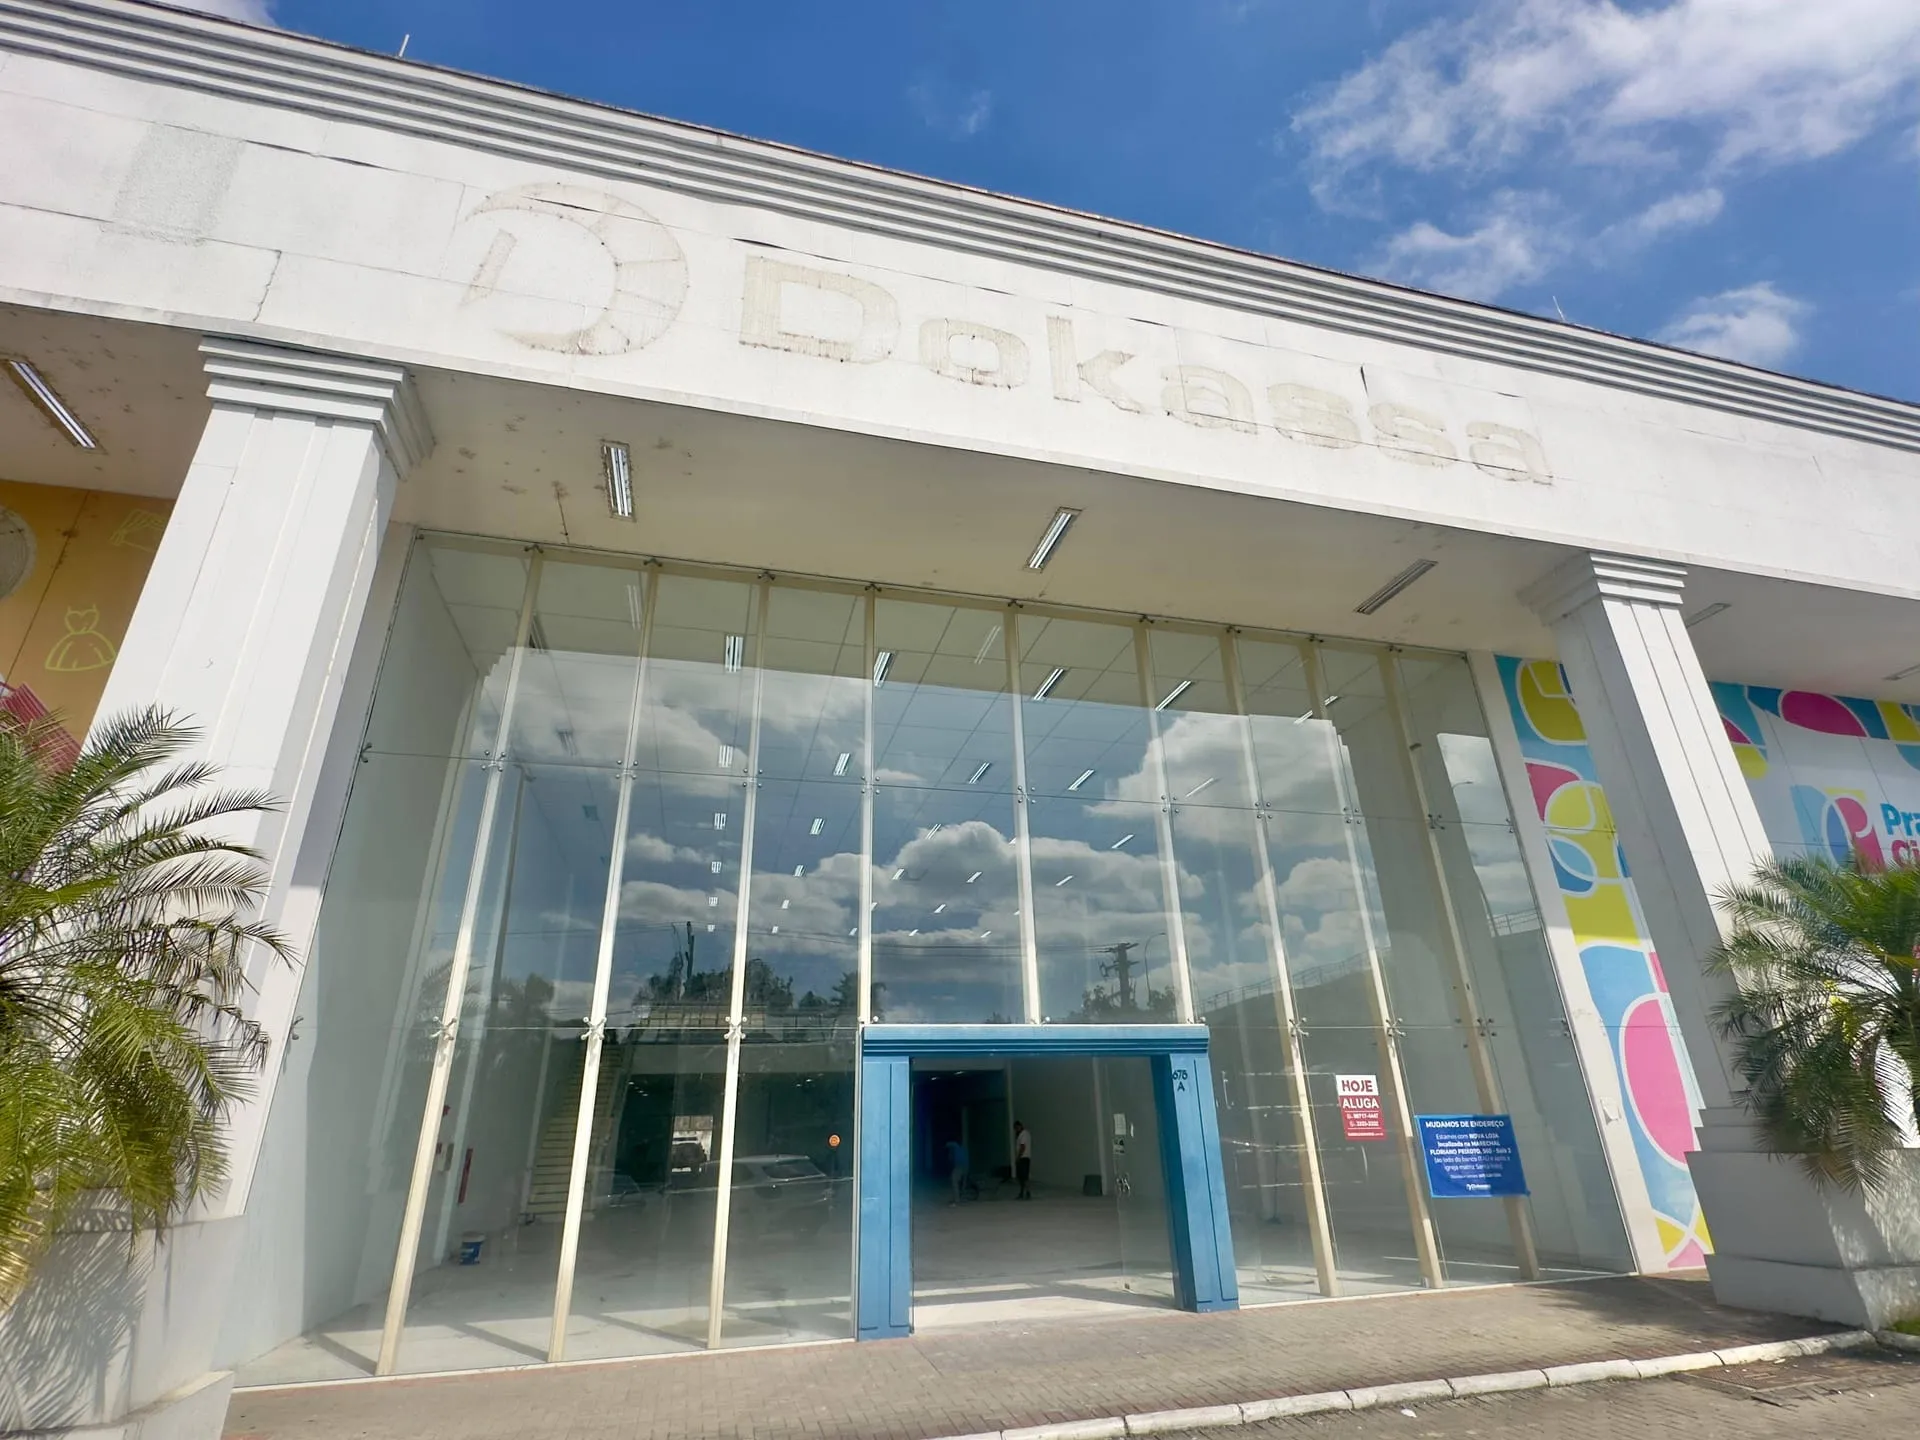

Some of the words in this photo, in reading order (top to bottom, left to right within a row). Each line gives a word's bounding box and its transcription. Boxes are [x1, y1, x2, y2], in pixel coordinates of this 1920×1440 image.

[737, 254, 1554, 487] Dokassa
[1176, 1080, 1185, 1092] A
[1341, 1080, 1373, 1092] HOJE
[1342, 1097, 1380, 1109] ALUGA
[1425, 1120, 1459, 1128] MUDAMOS
[1470, 1120, 1504, 1128] ENDEREÇO
